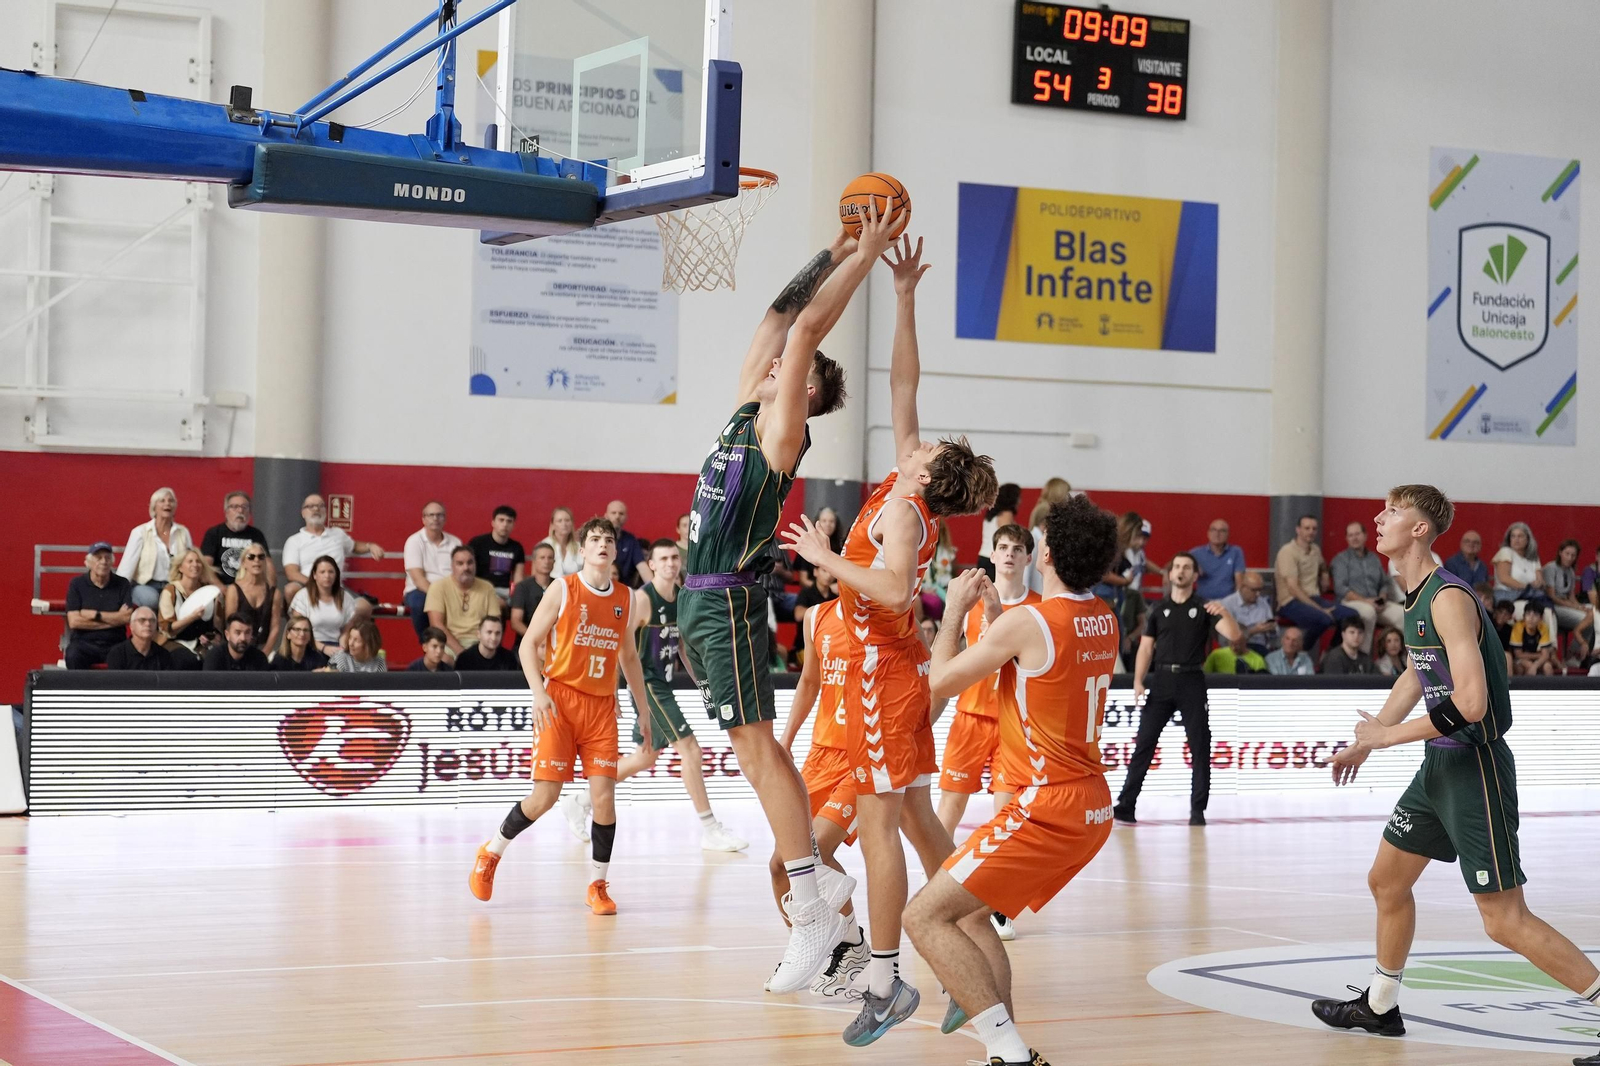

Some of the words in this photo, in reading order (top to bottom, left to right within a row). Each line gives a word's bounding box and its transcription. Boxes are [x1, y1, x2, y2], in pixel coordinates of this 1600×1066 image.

[1063, 8, 1148, 47] 09:09
[1026, 46, 1072, 65] LOCAL
[1137, 57, 1182, 77] VISITANTE
[1033, 69, 1072, 102] 54
[1097, 67, 1112, 90] 3
[512, 78, 531, 92] OS
[535, 81, 627, 101] PRINIPIOS
[629, 88, 658, 105] DL
[1087, 92, 1121, 109] PERIODO
[1146, 82, 1183, 115] 38
[512, 95, 554, 111] BUEN
[393, 183, 466, 203] MONDO
[840, 203, 878, 217] Wilon
[1040, 202, 1142, 222] POLIDEPORTIVO
[491, 248, 538, 258] TOLERANCIA
[1054, 229, 1127, 265] Blas
[553, 283, 607, 293] DEPORTIVIDAD
[1025, 265, 1153, 304] Infante
[1472, 291, 1535, 309] Fundación
[489, 310, 529, 319] ESFUERZO
[1482, 309, 1526, 329] Unicaja
[573, 337, 616, 346] EDUCACIÓN
[1472, 325, 1535, 341] Baloncesto
[577, 621, 613, 638] Cultura
[1073, 614, 1114, 637] CAROT
[573, 633, 618, 650] Esfuerzo
[588, 654, 607, 679] 13
[822, 657, 847, 672] Cult
[946, 768, 968, 778] PULEVA
